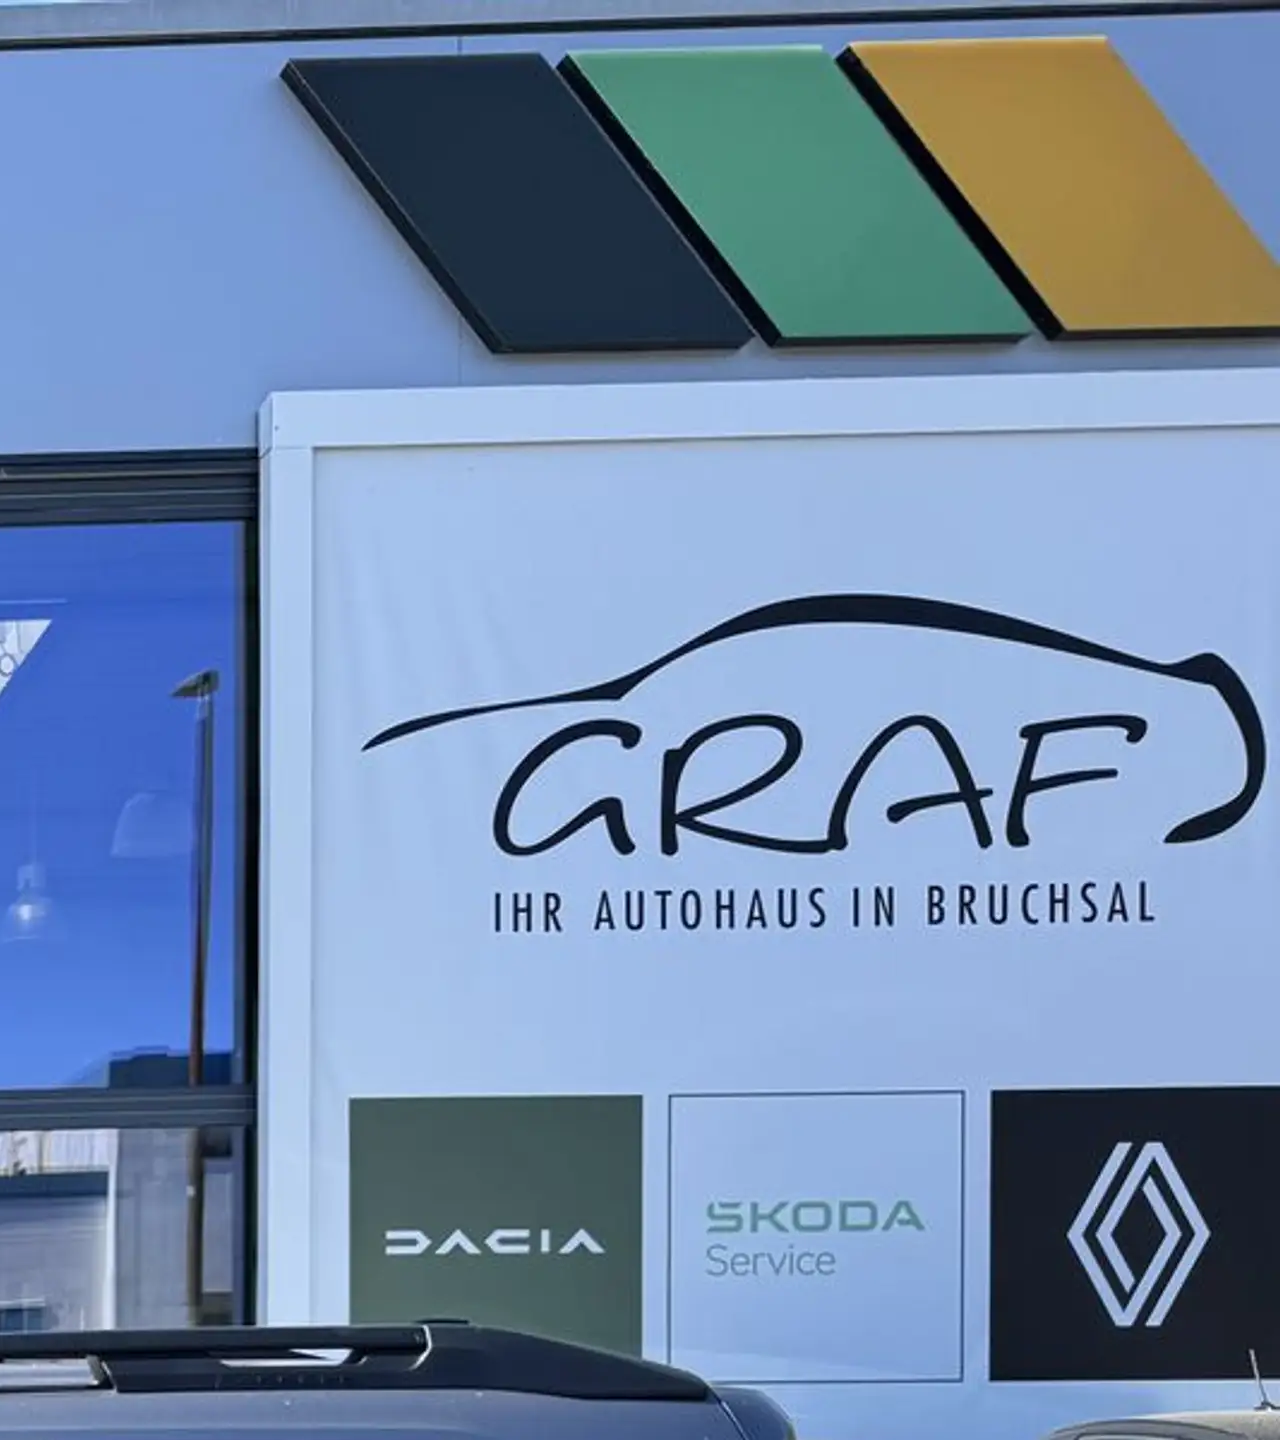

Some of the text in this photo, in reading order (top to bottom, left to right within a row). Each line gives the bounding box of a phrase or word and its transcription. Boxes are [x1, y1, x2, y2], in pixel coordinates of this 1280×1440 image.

[492, 713, 1148, 857] GRAF
[493, 881, 1155, 933] IHR AUTOHAUS IN BRUCHSAL
[385, 1228, 606, 1256] DACIA
[705, 1243, 836, 1276] Service
